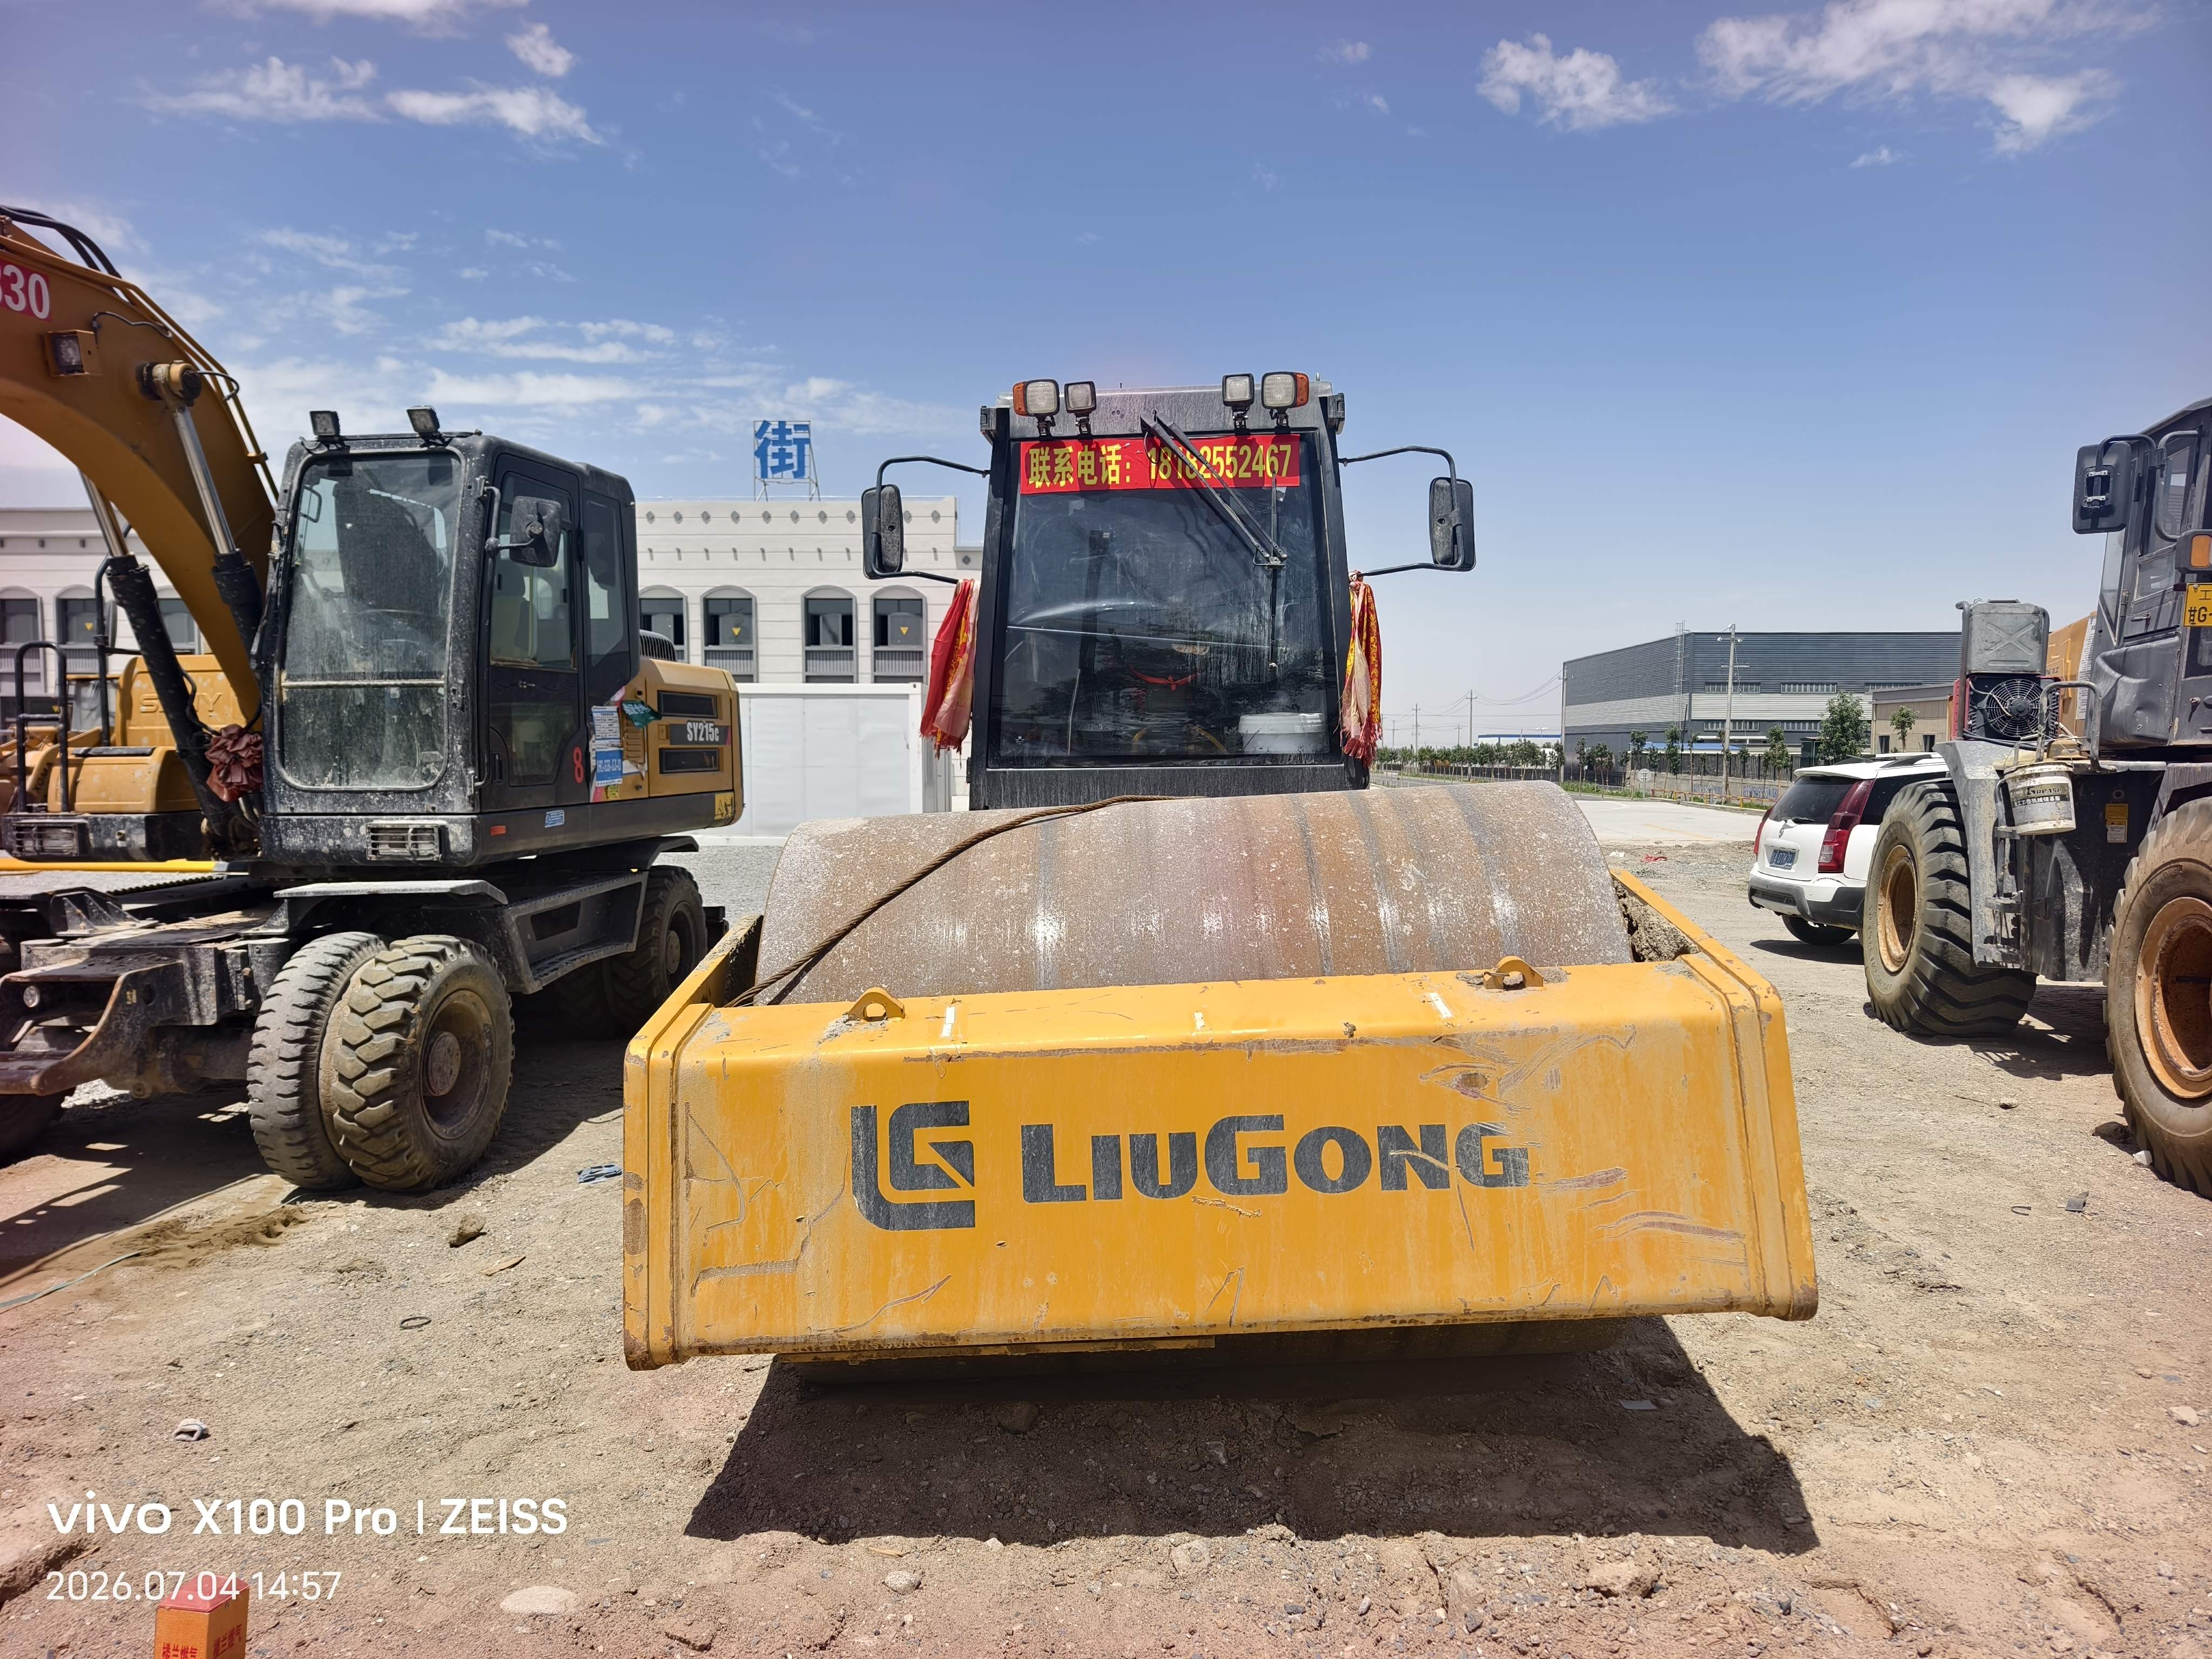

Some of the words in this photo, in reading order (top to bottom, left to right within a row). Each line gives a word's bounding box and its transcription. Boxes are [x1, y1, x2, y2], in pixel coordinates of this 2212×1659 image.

[0, 264, 50, 319] 30
[754, 420, 810, 479] 街
[1147, 444, 1291, 480] 18182552467
